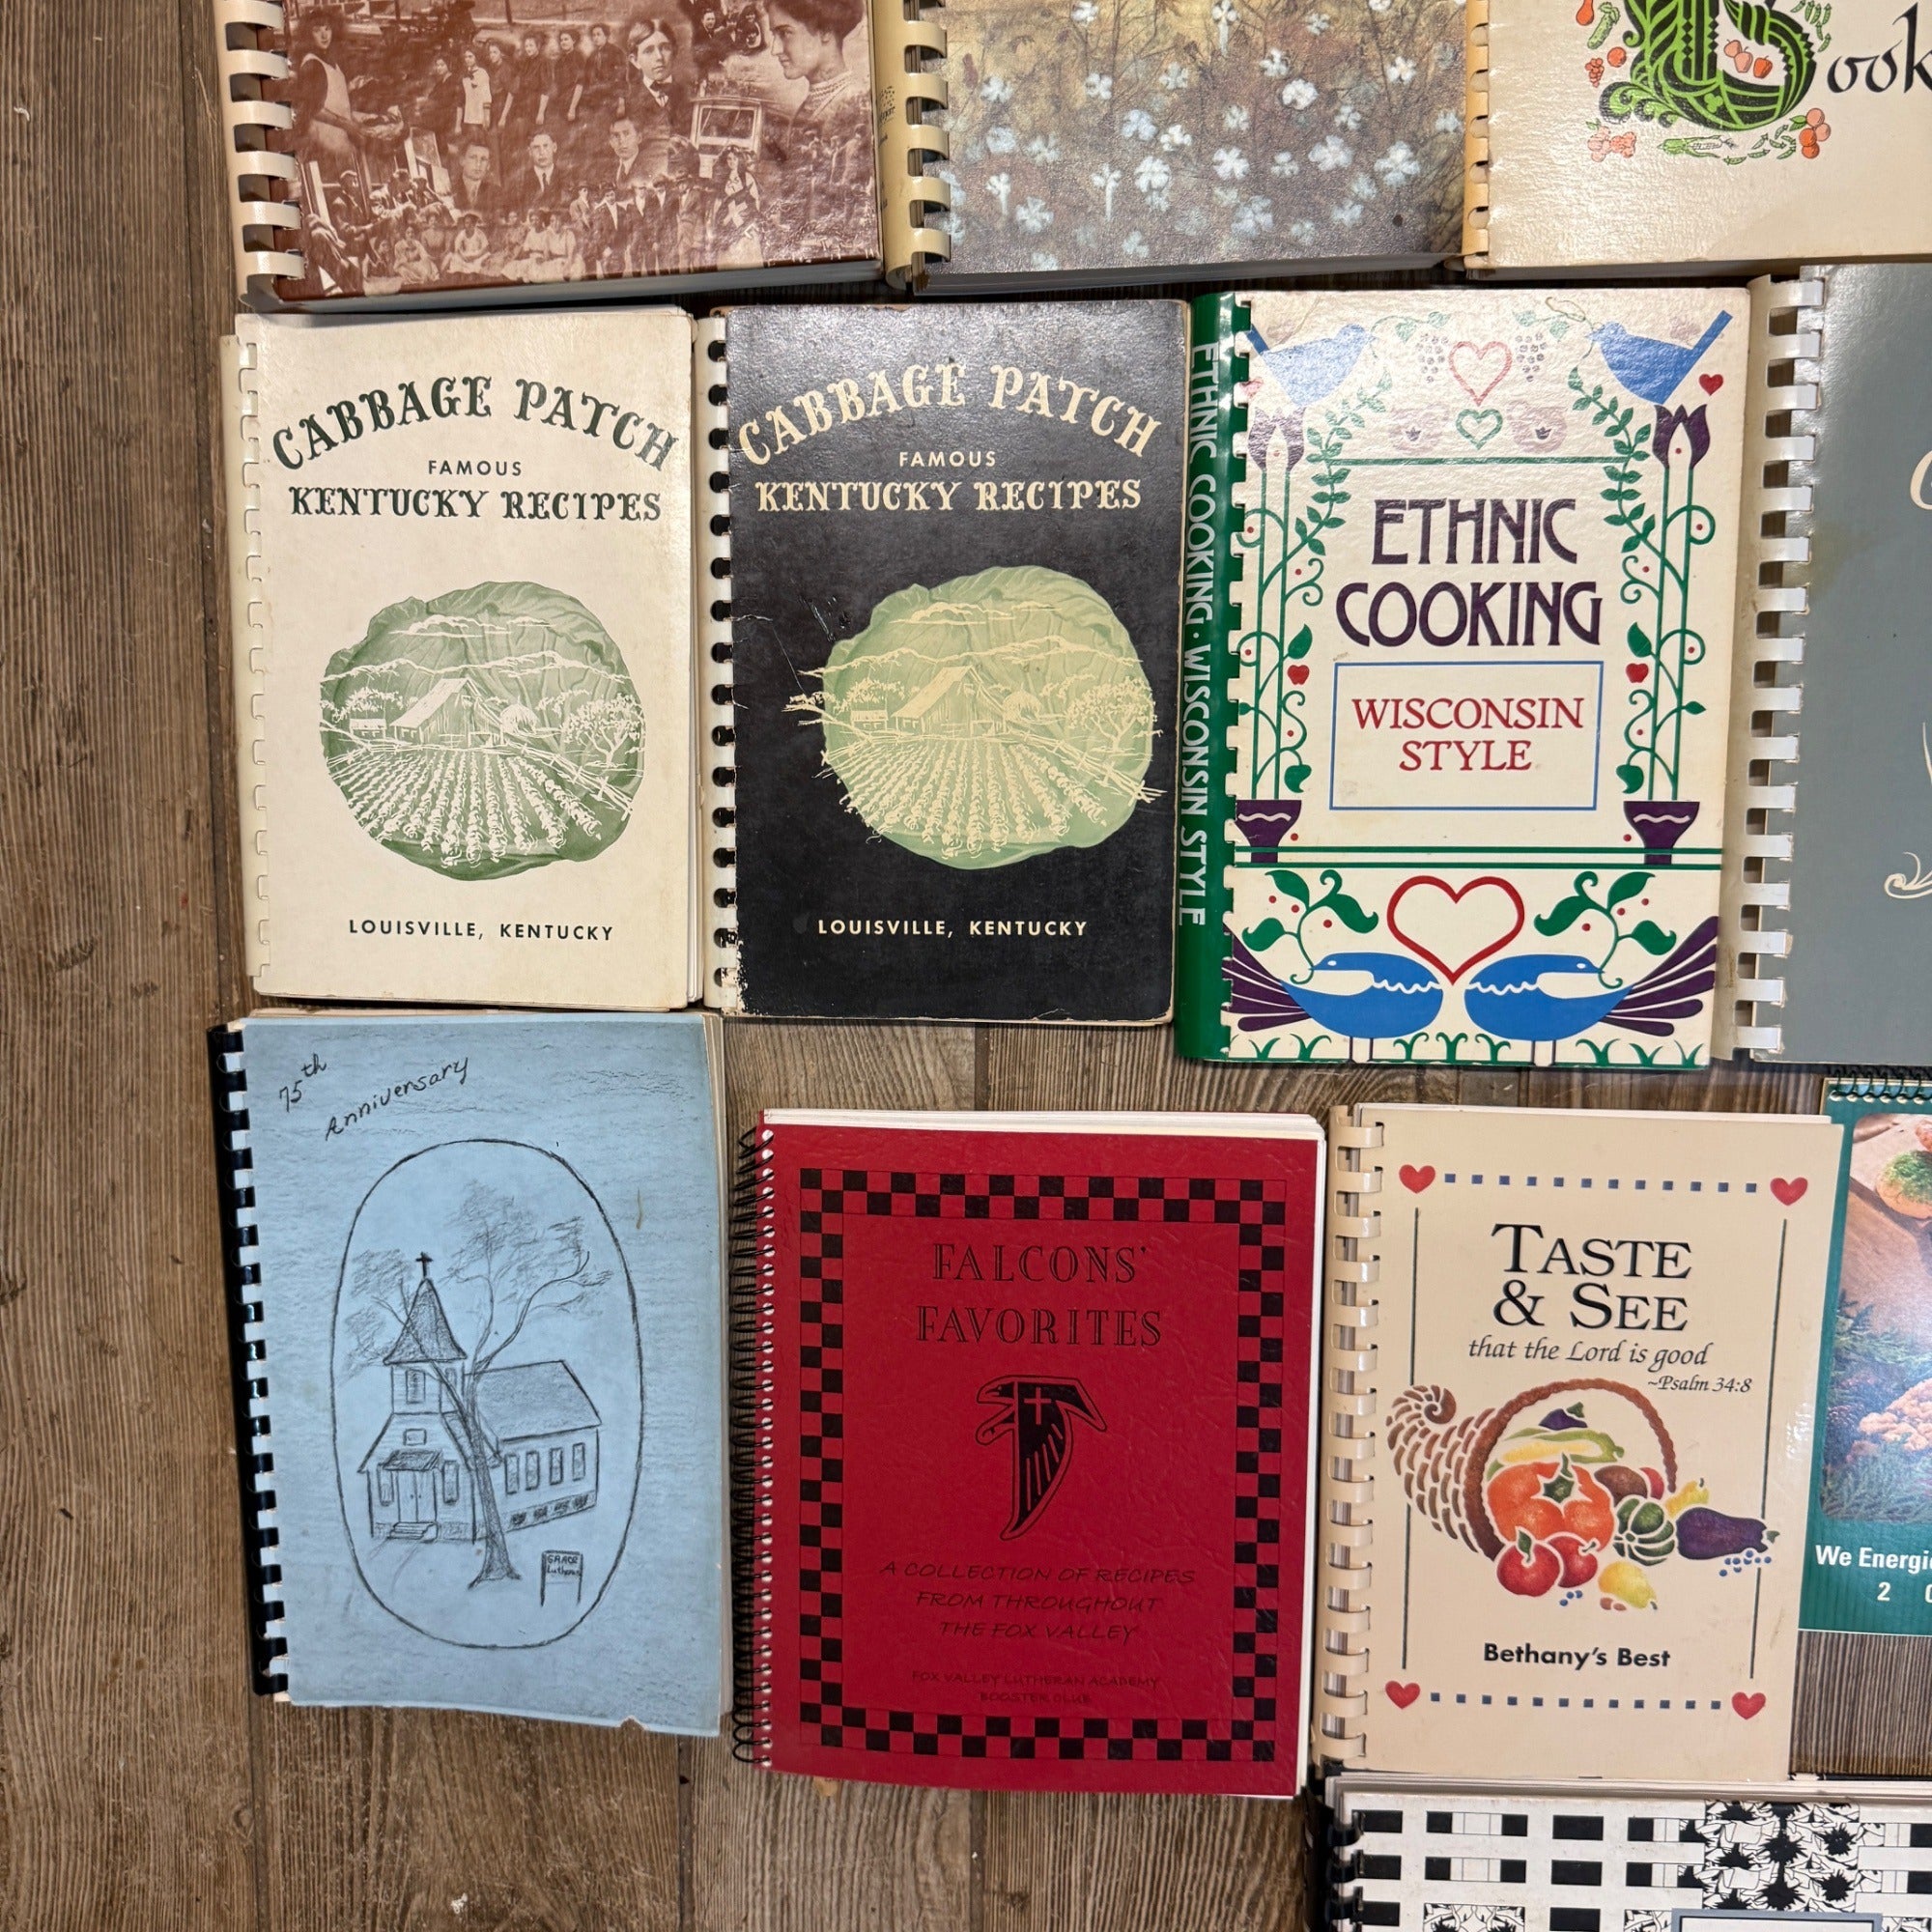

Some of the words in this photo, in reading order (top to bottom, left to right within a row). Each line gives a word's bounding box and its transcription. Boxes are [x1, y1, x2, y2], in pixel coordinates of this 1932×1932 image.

[738, 362, 966, 466] CABBAGE
[988, 364, 1162, 458] PATCH
[1189, 342, 1219, 464] ETHNIC
[272, 376, 493, 470] CABBAGE
[513, 378, 679, 472] PATCH
[428, 460, 523, 477] FAMOUS
[899, 450, 997, 468] FAMOUS
[288, 486, 490, 519] KENTUCKY
[499, 491, 662, 522] RECIPES
[754, 481, 963, 512] KENTUCKY
[974, 479, 1142, 511] RECIPES
[1371, 498, 1578, 564] ETHNIC
[1185, 473, 1216, 626] COOKING
[1335, 581, 1604, 647] COOKING
[1180, 643, 1210, 816] WISCONSIN
[1351, 697, 1585, 729] WISCONSIN
[1399, 740, 1533, 771] STYLE
[1179, 825, 1208, 926] STYLE
[349, 919, 484, 940] LOUISVILLE,
[499, 923, 613, 941] KENTUCKY
[818, 919, 954, 938] LOUISVILLE,
[969, 921, 1088, 936] KENTUCKY
[325, 1057, 469, 1142] Anniversary
[1491, 1223, 1692, 1279] TASTE
[1492, 1279, 1546, 1327] &
[1570, 1282, 1690, 1332] SEE
[916, 1305, 1162, 1347] FAVORITES
[1468, 1335, 1518, 1359] that
[1523, 1337, 1560, 1361] the
[1565, 1339, 1629, 1364] Lord
[1629, 1343, 1649, 1364] is
[1648, 1342, 1714, 1373] good
[1712, 1377, 1753, 1393] 34:8
[879, 1560, 896, 1577] A
[904, 1562, 1052, 1582] COLLECTION
[1058, 1568, 1092, 1582] OF
[1095, 1569, 1197, 1584] RECIPES
[1815, 1545, 1852, 1566] We
[1859, 1547, 1932, 1575] Energi
[916, 1591, 984, 1608] FROM
[992, 1593, 1162, 1614] THROUGHOUT
[1877, 1581, 1891, 1602] 2
[940, 1621, 987, 1637] THE
[990, 1623, 1037, 1639] FOX
[1045, 1625, 1140, 1647] VALLEY
[1483, 1642, 1607, 1670] Bethany's
[1617, 1647, 1671, 1667] Best
[912, 1670, 939, 1682] FOX
[943, 1672, 1000, 1688] VALLEY
